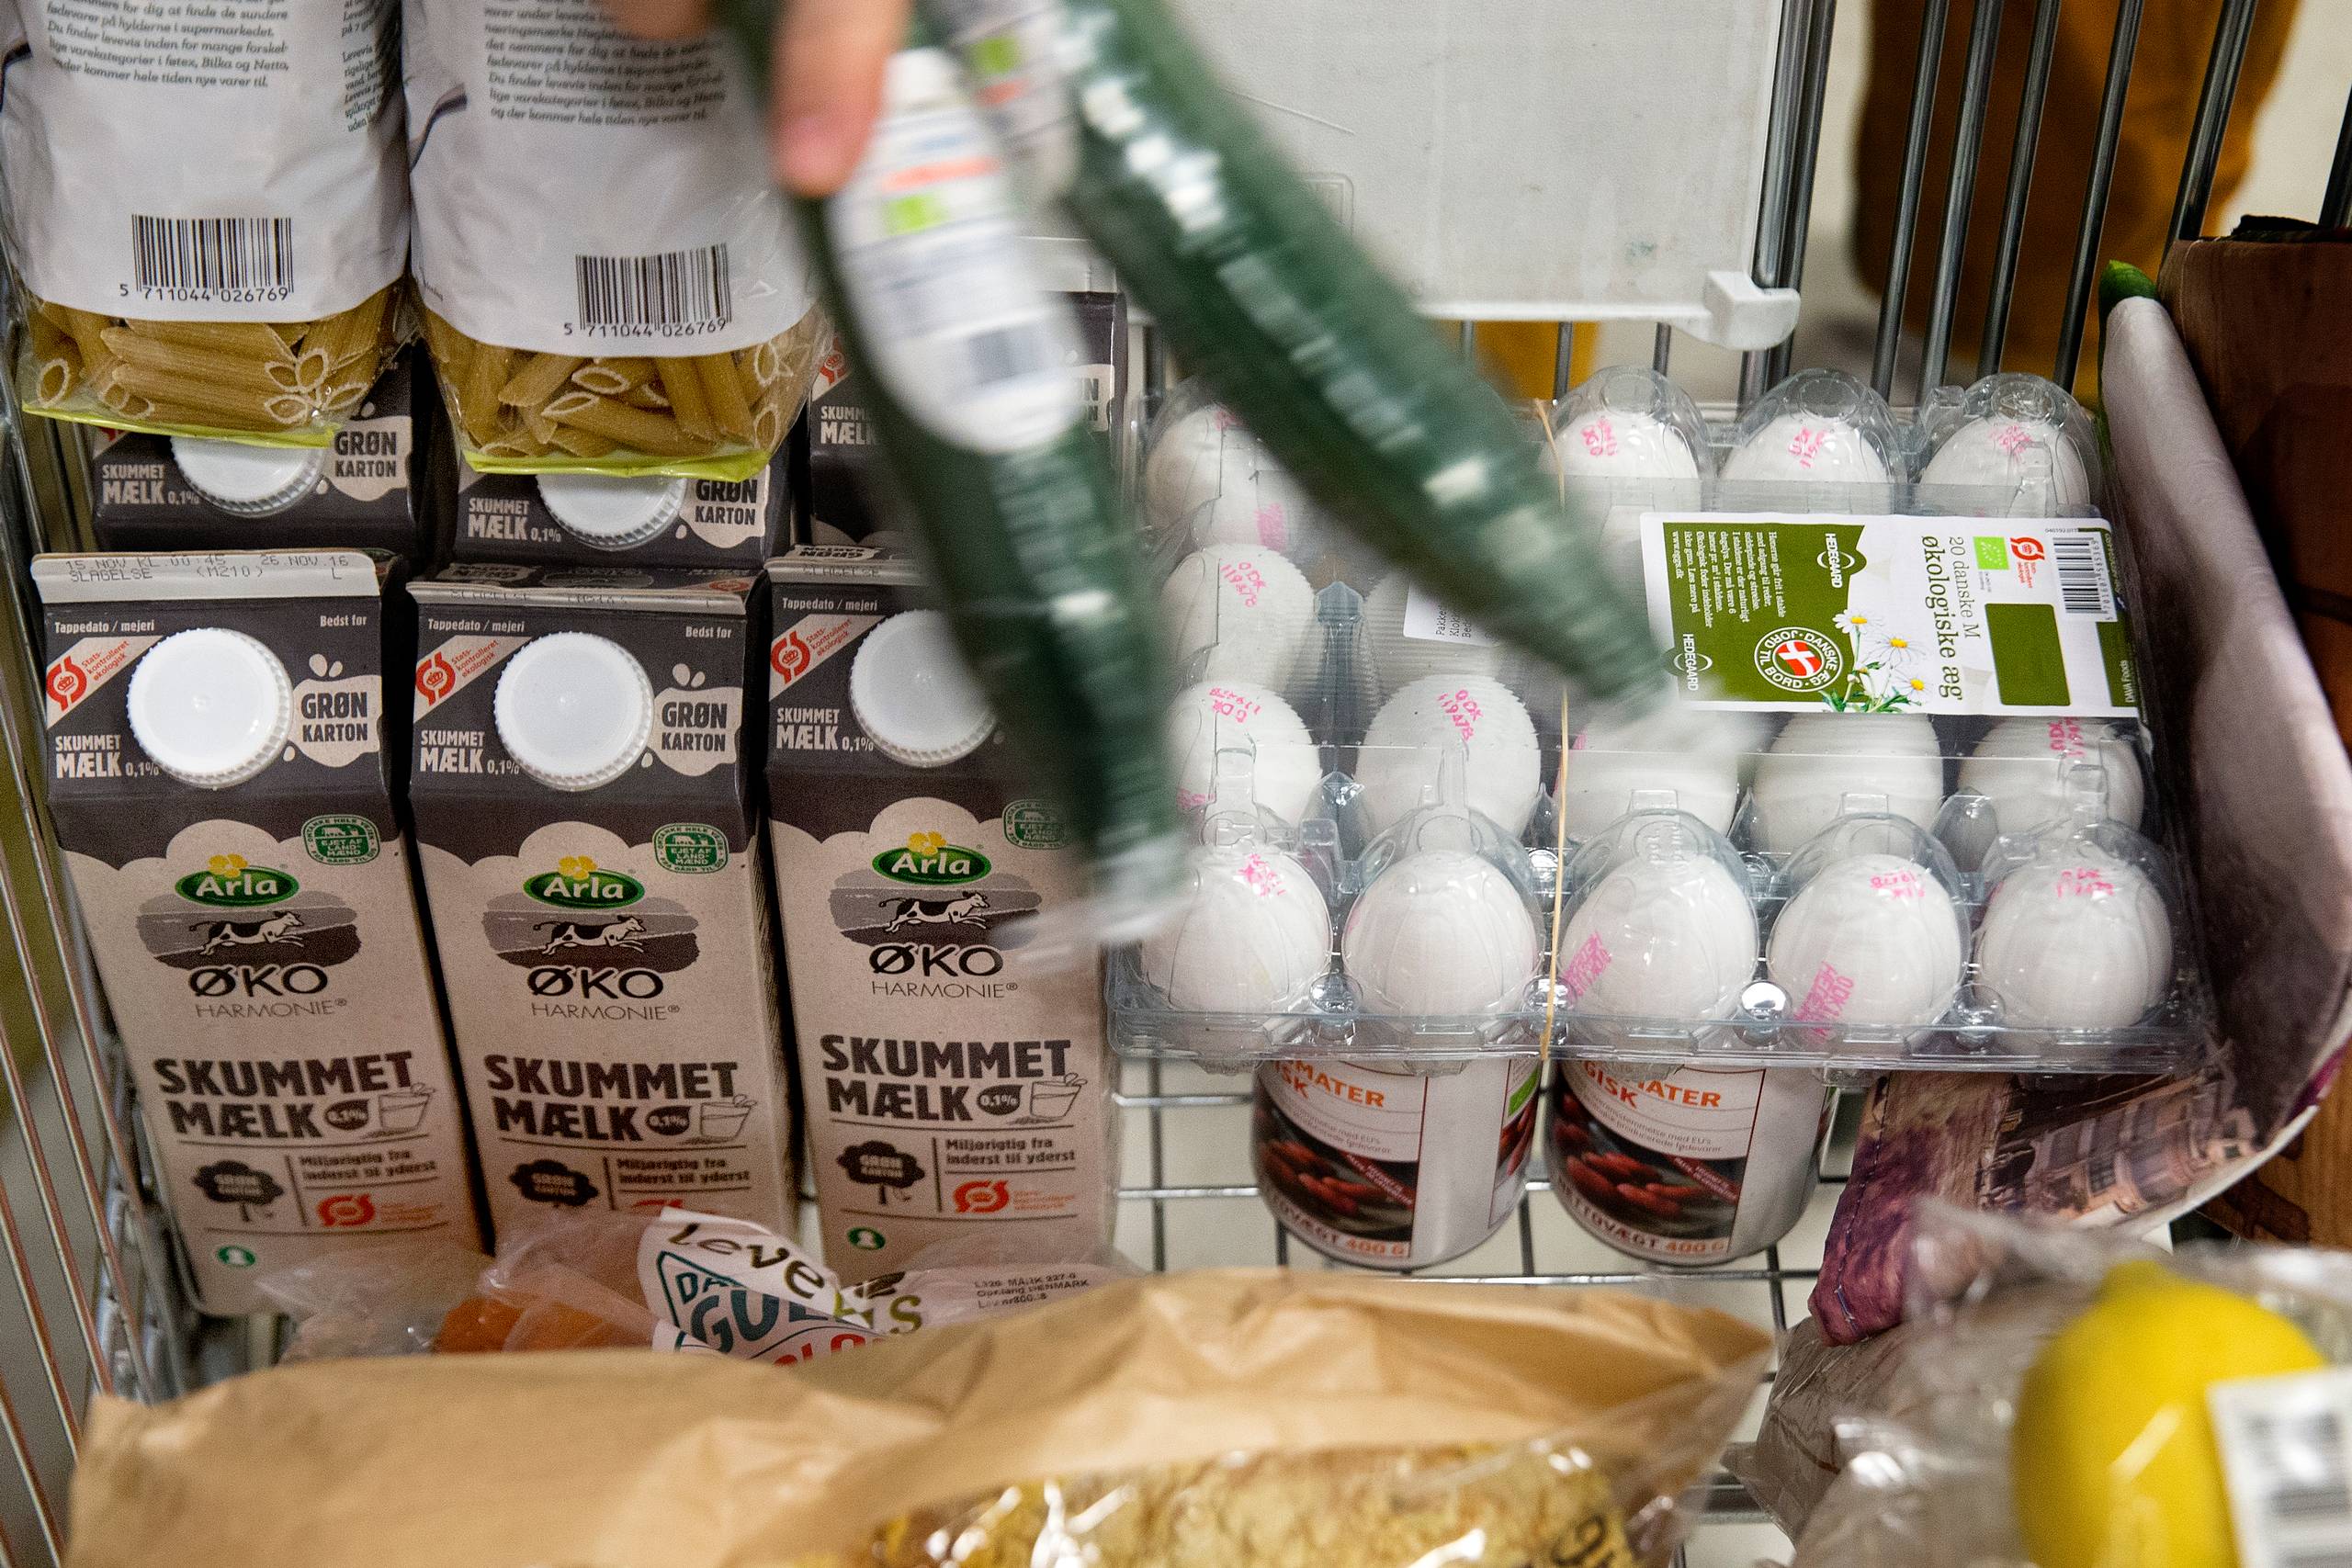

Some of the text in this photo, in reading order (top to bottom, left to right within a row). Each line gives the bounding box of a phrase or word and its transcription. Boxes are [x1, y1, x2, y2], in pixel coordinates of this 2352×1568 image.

[144, 4, 164, 17] dig
[168, 7, 181, 16] at
[186, 5, 216, 17] finde
[221, 8, 235, 18] de
[100, 15, 116, 28] på
[119, 17, 171, 32] hylderne
[48, 20, 64, 33] Du
[66, 23, 98, 40] finder
[143, 38, 177, 50] inden
[181, 38, 198, 50] for
[201, 42, 243, 54] mange
[202, 56, 232, 69] Bilka
[235, 61, 250, 73] og
[133, 69, 159, 83] hele
[162, 71, 192, 84] tiden
[195, 75, 217, 87] nye
[220, 75, 251, 88] varer
[119, 284, 288, 302] 5 711044 026769
[564, 317, 727, 337] 5 711044 026769
[820, 406, 870, 421] SKUMM
[334, 431, 397, 457] GRØN
[102, 464, 165, 480] SKUMMET
[334, 460, 397, 478] KARTON
[102, 480, 165, 505] MÆLK
[695, 479, 758, 504] GRØN
[469, 498, 530, 514] SKUMMET
[695, 505, 756, 525] KARTON
[468, 514, 529, 541] MÆLK
[66, 560, 84, 570] 15
[95, 558, 126, 569] NOV
[1671, 531, 1684, 580] www.eggs.dk
[1825, 533, 1843, 589] HEDEGAARD
[70, 568, 153, 582] SLAGELSE
[332, 566, 343, 581] L
[1688, 568, 1697, 584] Læs
[1700, 569, 1710, 589] foder
[1723, 562, 1733, 576] Der
[1736, 567, 1744, 575] er
[1747, 570, 1757, 581] og
[1736, 576, 1747, 589] der
[1761, 577, 1770, 585] til
[1772, 578, 1783, 591] frit
[1949, 536, 1981, 638] 20 danske M
[782, 597, 878, 612] Tappedato / mejeri
[54, 619, 155, 635] Tappedato / mejeri
[320, 615, 368, 627] Bedst før
[428, 618, 526, 635] Tappedato / mejeri
[685, 626, 732, 639] Bedst før
[1682, 634, 1699, 691] HEDEGAARD
[1758, 628, 1804, 689] JORD TIL BORD
[1804, 632, 1838, 687] DANSKE ÆG
[2118, 660, 2131, 682] Foods
[1939, 666, 1963, 700] æg
[301, 692, 368, 719] GRØN
[662, 701, 728, 729] GRØN
[776, 706, 841, 725] SKUMMET
[301, 722, 368, 743] KARTON
[420, 729, 485, 746] SKUMMET
[662, 732, 727, 752] KARTON
[776, 724, 875, 752] MÆLK 0,1%
[55, 734, 122, 752] SKUMMET
[56, 752, 122, 780] MÆLK
[420, 746, 521, 775] MÆLK 0,1%
[891, 852, 971, 875] Arla
[196, 874, 278, 897] Arla
[542, 876, 625, 900] Arla
[868, 943, 1004, 977] ØKO
[187, 964, 329, 999] ØKO
[526, 966, 664, 999] ØKO
[820, 1034, 1071, 1079] SKUMMET
[153, 1051, 413, 1097] SKUMMET
[483, 1055, 738, 1100] SKUMMET
[1584, 1060, 1638, 1109] GISK
[826, 1077, 974, 1122] MÆLK
[166, 1100, 323, 1139] MÆLK
[492, 1096, 644, 1142] MÆLK
[1030, 1136, 1053, 1149] fra
[945, 1150, 1076, 1167] inderst til yderst
